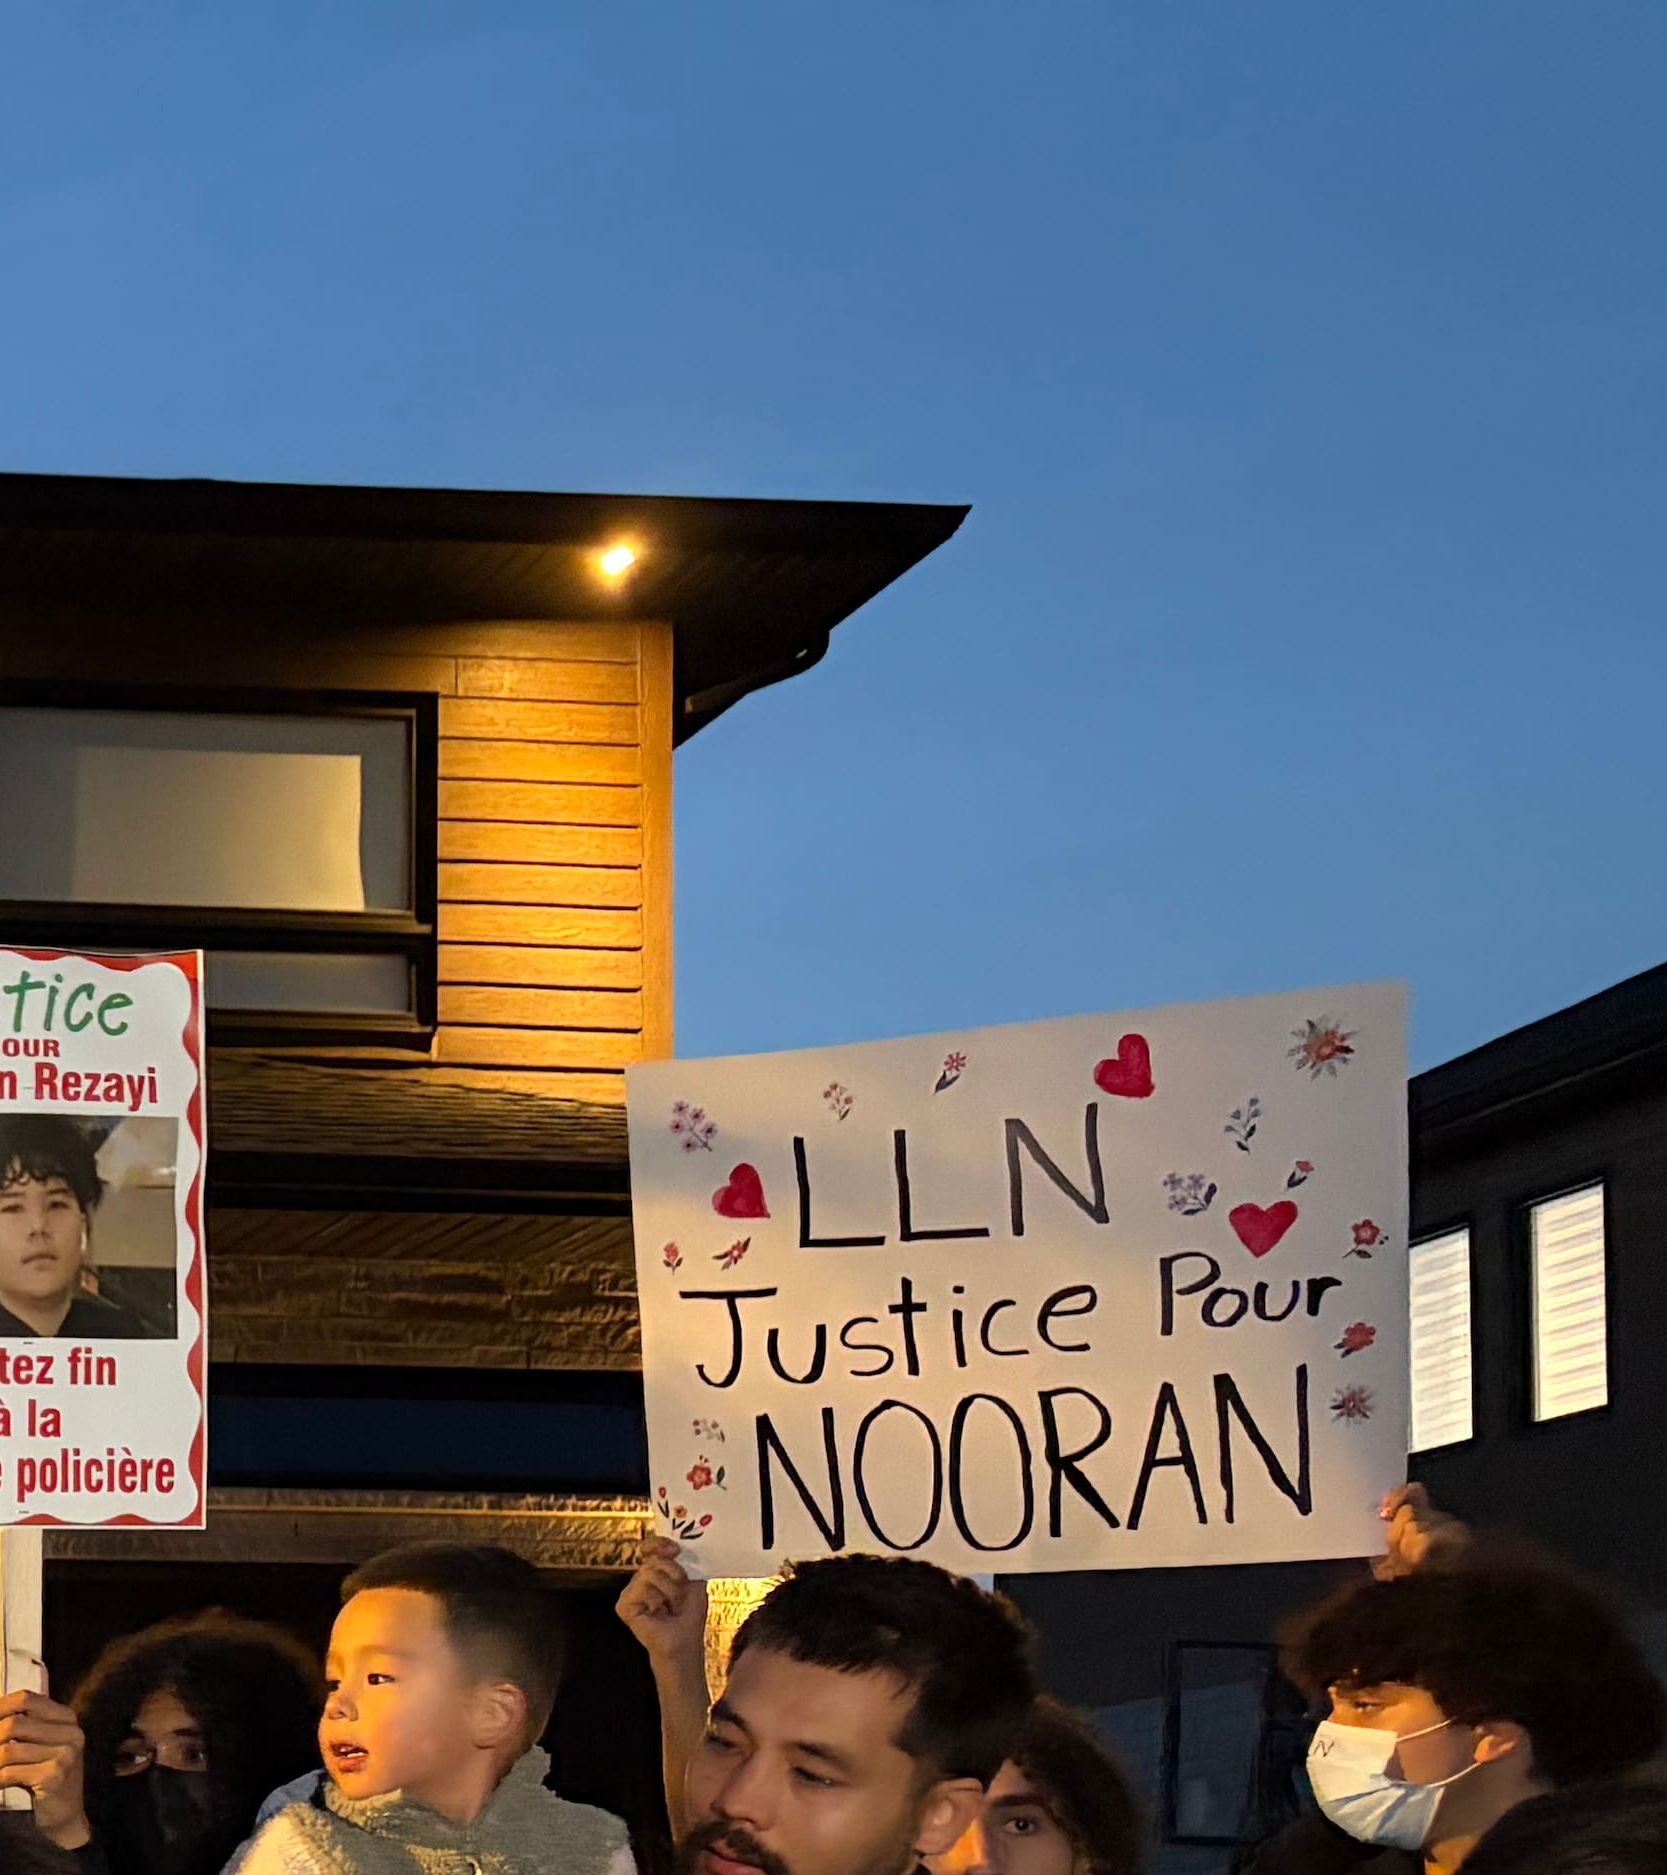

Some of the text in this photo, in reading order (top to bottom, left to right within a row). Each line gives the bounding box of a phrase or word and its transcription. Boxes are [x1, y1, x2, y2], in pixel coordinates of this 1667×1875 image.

[33, 1063, 159, 1112] Rezayi
[793, 1102, 1111, 1250] LLN
[678, 1251, 1343, 1389] Justice Pour
[68, 1346, 117, 1385] fin
[27, 1400, 62, 1438] la
[16, 1446, 176, 1503] policière
[756, 1363, 1313, 1553] NOORAN
